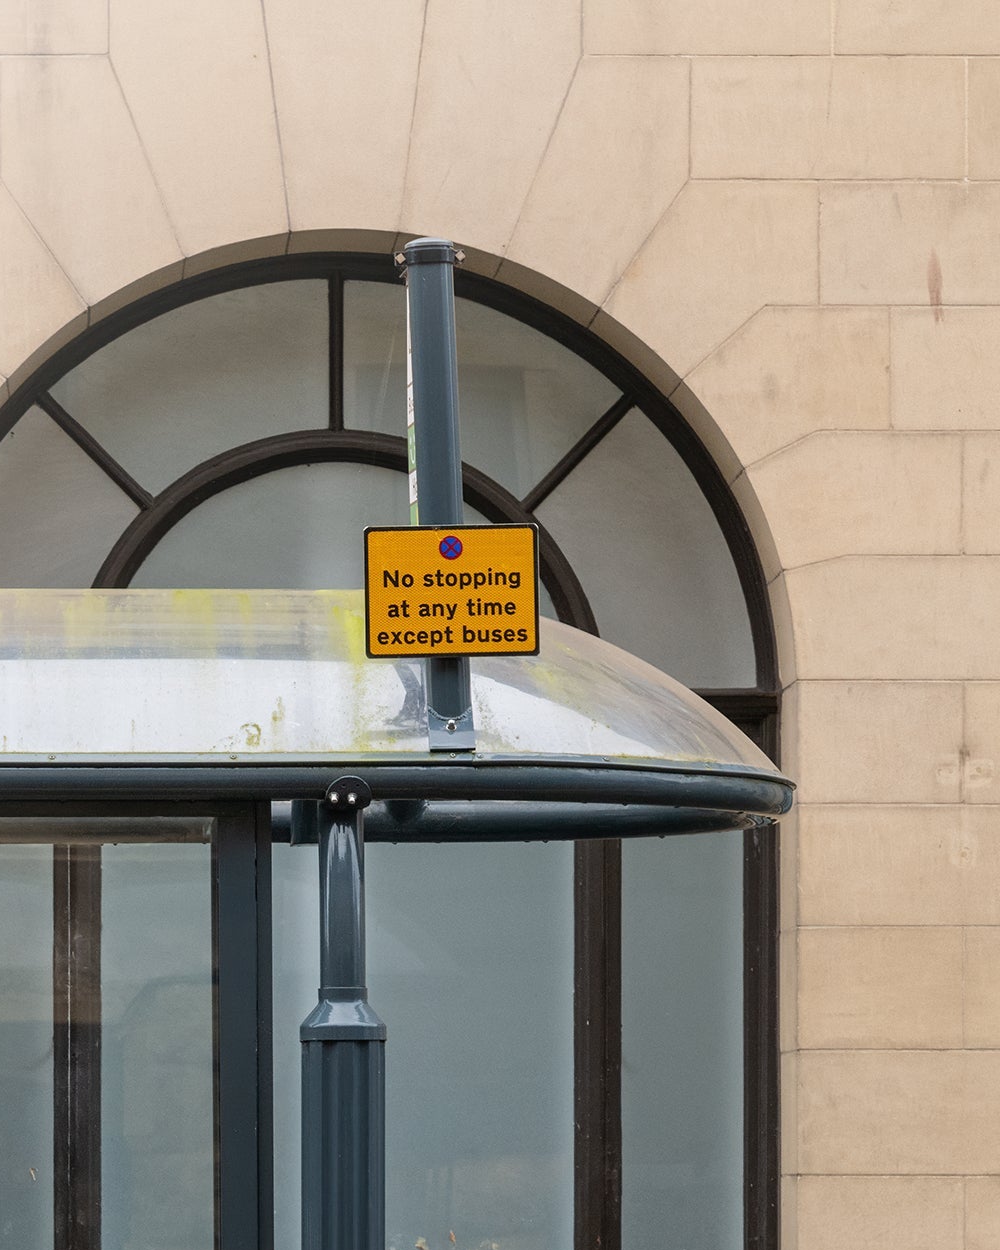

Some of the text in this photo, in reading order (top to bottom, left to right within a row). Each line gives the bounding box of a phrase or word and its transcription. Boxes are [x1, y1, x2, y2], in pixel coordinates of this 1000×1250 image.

[383, 567, 521, 590] No stopping
[387, 598, 517, 621] at any time
[377, 624, 529, 648] except buses
